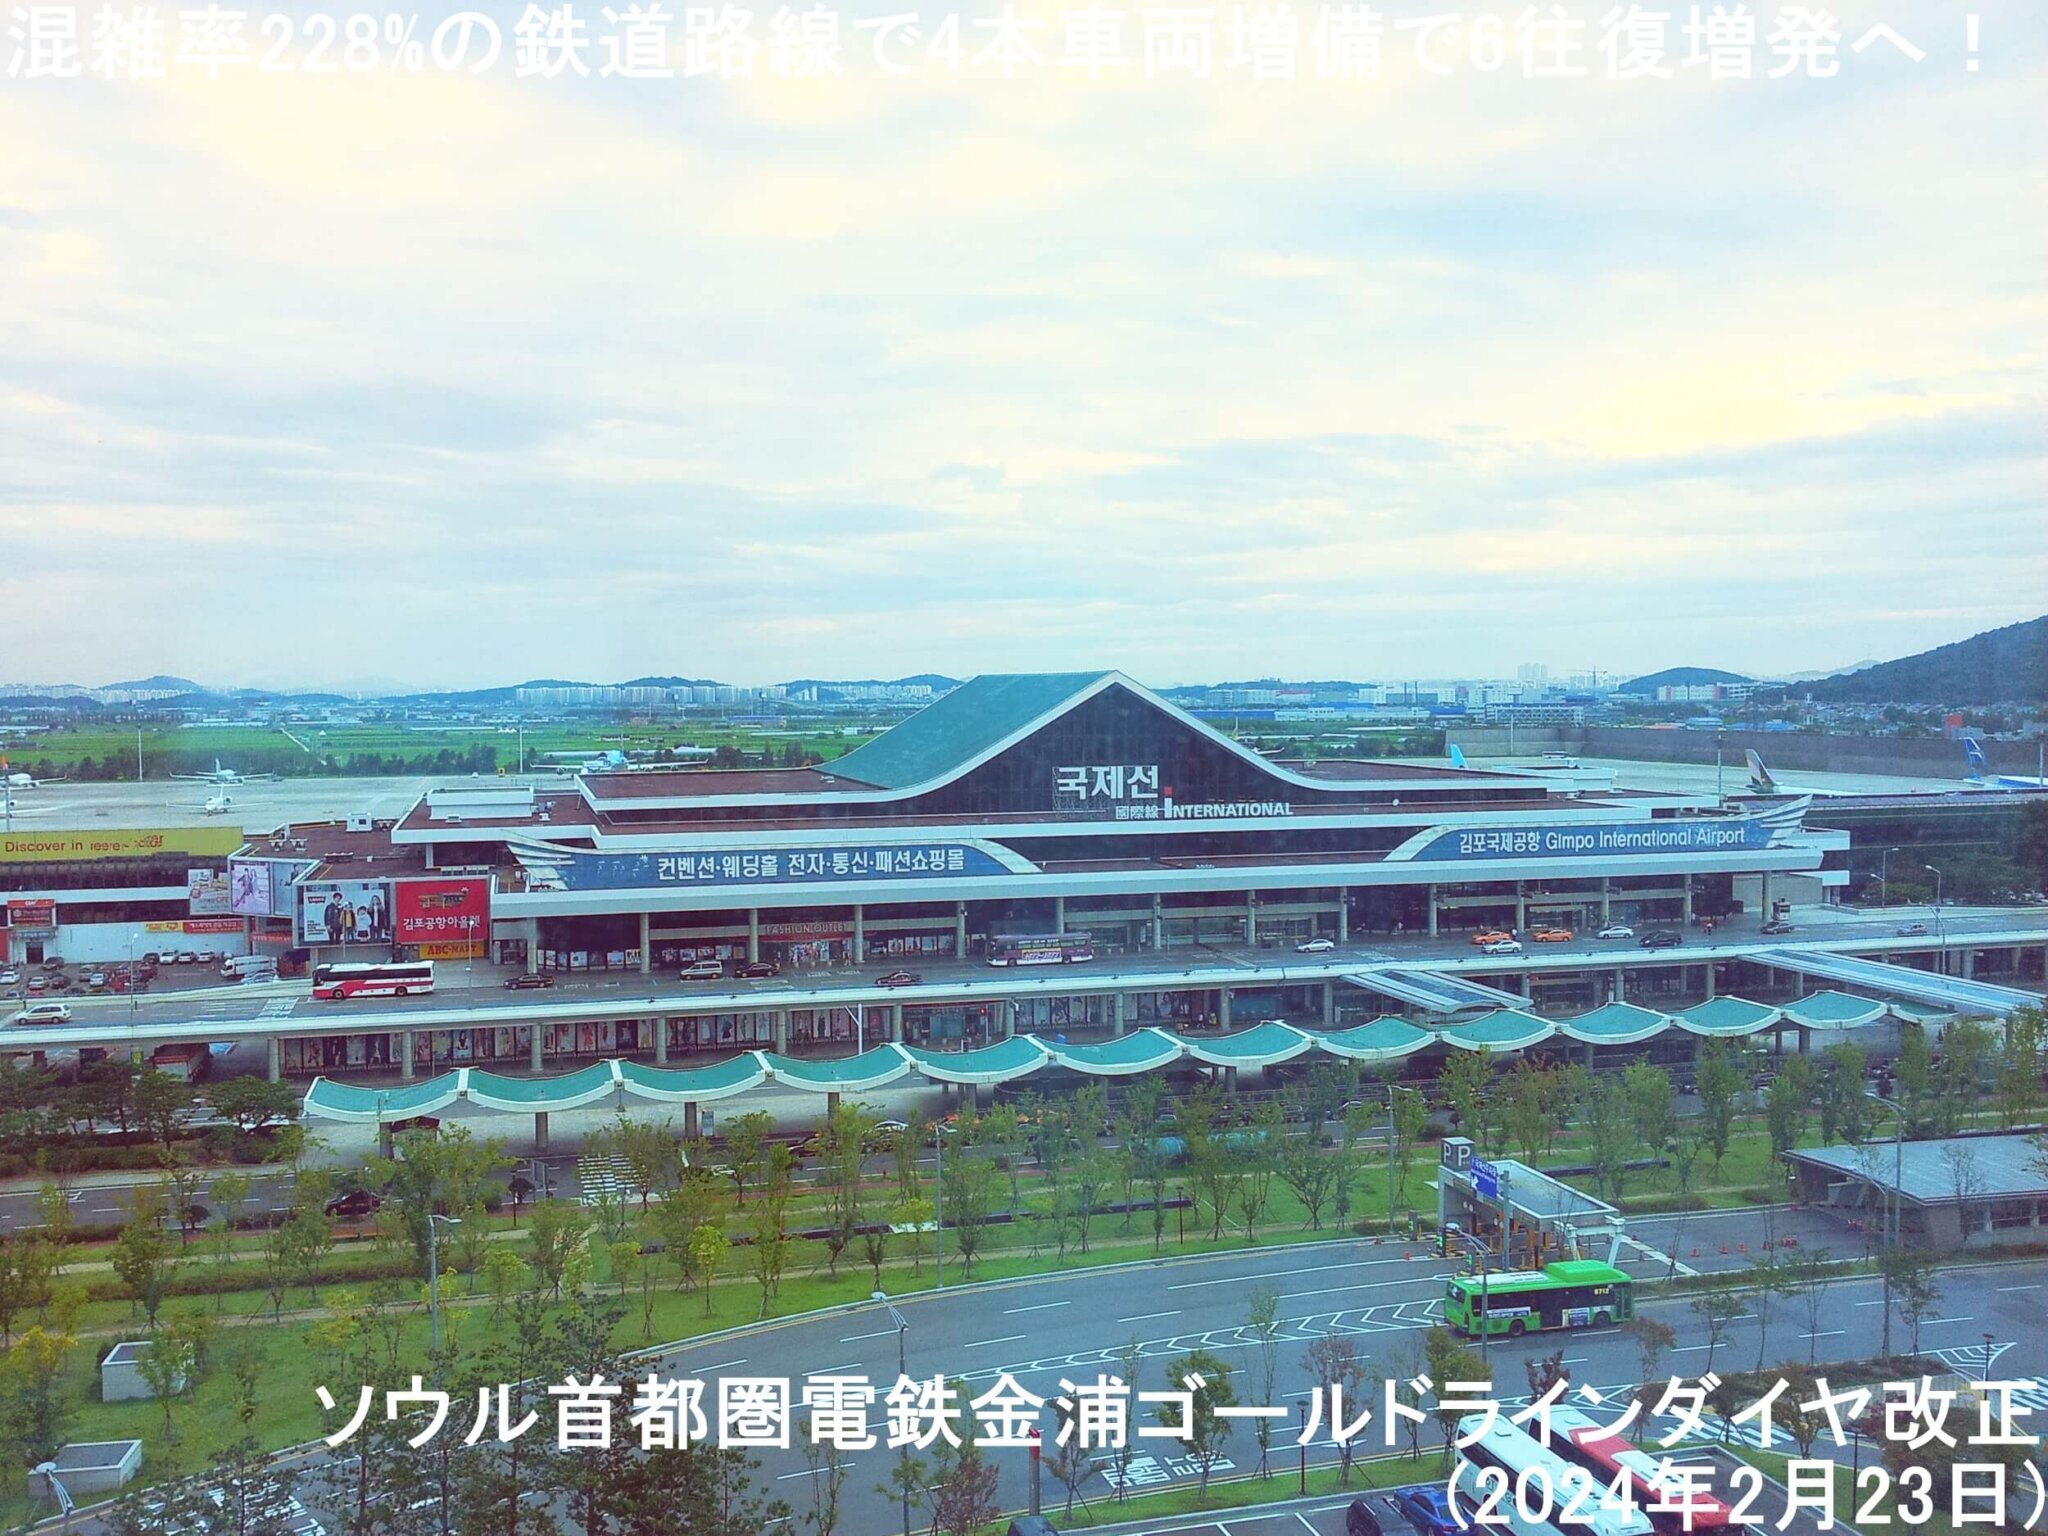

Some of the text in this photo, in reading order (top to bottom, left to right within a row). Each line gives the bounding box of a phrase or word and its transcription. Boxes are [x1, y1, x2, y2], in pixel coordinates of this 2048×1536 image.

[1057, 767, 1158, 799] 국제선
[1115, 805, 1159, 820] 國際線
[5, 841, 65, 852] Discover
[72, 839, 83, 850] in
[1459, 832, 1541, 853] 김포국제공항
[1546, 827, 1745, 852] Gimpo International Airport
[658, 854, 778, 880] 컨벤션·웨딩홀
[403, 915, 480, 931] 김포공항아울렛
[766, 921, 848, 935] FASHION OUTLET
[427, 943, 477, 955] ABC-MART
[1457, 1145, 1471, 1167] P
